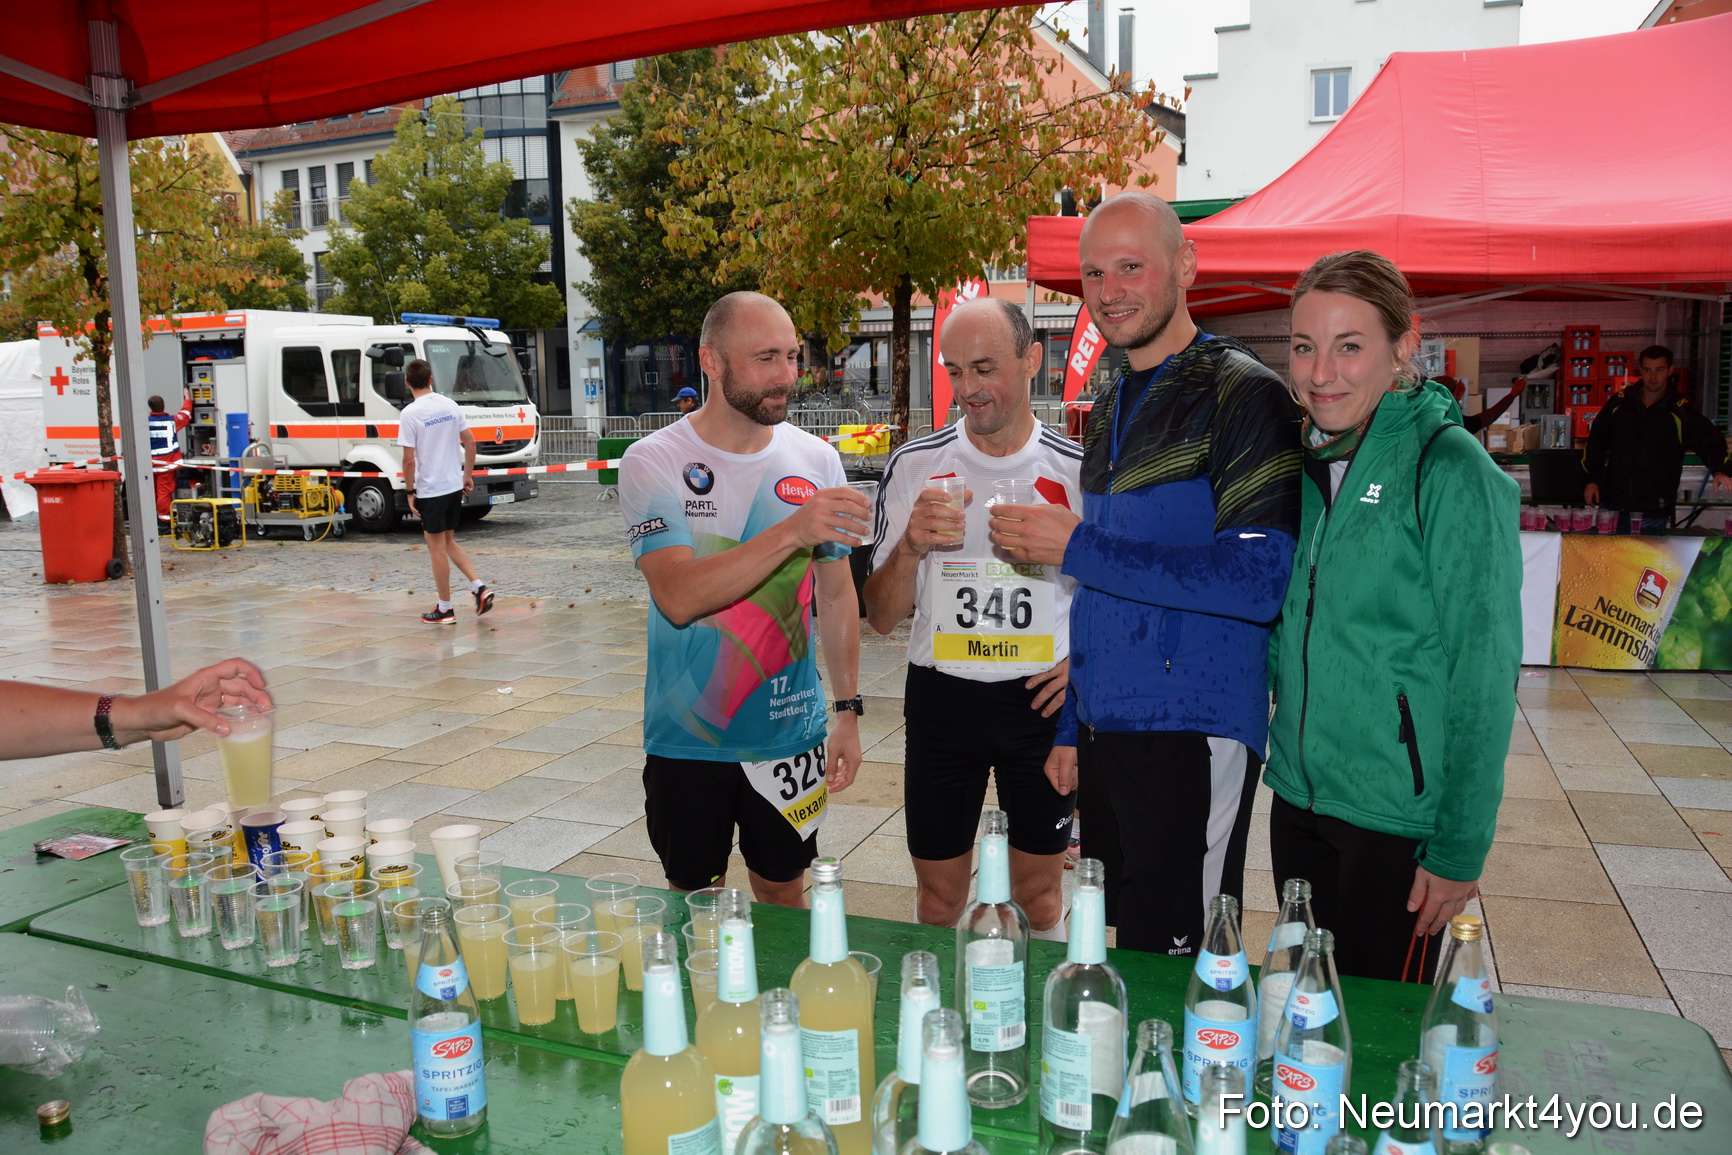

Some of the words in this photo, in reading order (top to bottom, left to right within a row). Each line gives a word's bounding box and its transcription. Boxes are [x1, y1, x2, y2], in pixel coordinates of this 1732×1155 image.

[984, 262, 1027, 280] TREB
[1070, 321, 1101, 377] REW
[846, 360, 871, 368] STREB
[72, 376, 90, 385] Rotes
[73, 387, 91, 396] Kreuz
[781, 483, 815, 498] Hervis
[685, 500, 718, 511] PARTL
[685, 510, 718, 518] Neumarkt
[941, 571, 979, 579] NeuerMarkt
[985, 562, 1045, 577] BOCK
[956, 586, 1033, 629] 346
[1594, 595, 1661, 645] Neumarkte
[1563, 604, 1656, 668] Lammsbr
[967, 640, 1019, 658] Martin
[770, 676, 792, 695] 17.
[769, 702, 808, 721] Stadtlauf
[773, 742, 827, 800] 328
[1168, 946, 1192, 956] erima
[433, 977, 460, 987] SPRITZIG
[432, 1038, 471, 1057] SAPS
[1197, 1030, 1238, 1047] SAPS
[1187, 1050, 1248, 1069] SPRZIG
[422, 1058, 482, 1080] SPRITZIG
[1278, 1066, 1313, 1089] SAPS
[431, 1078, 478, 1093] TAFELWASSER
